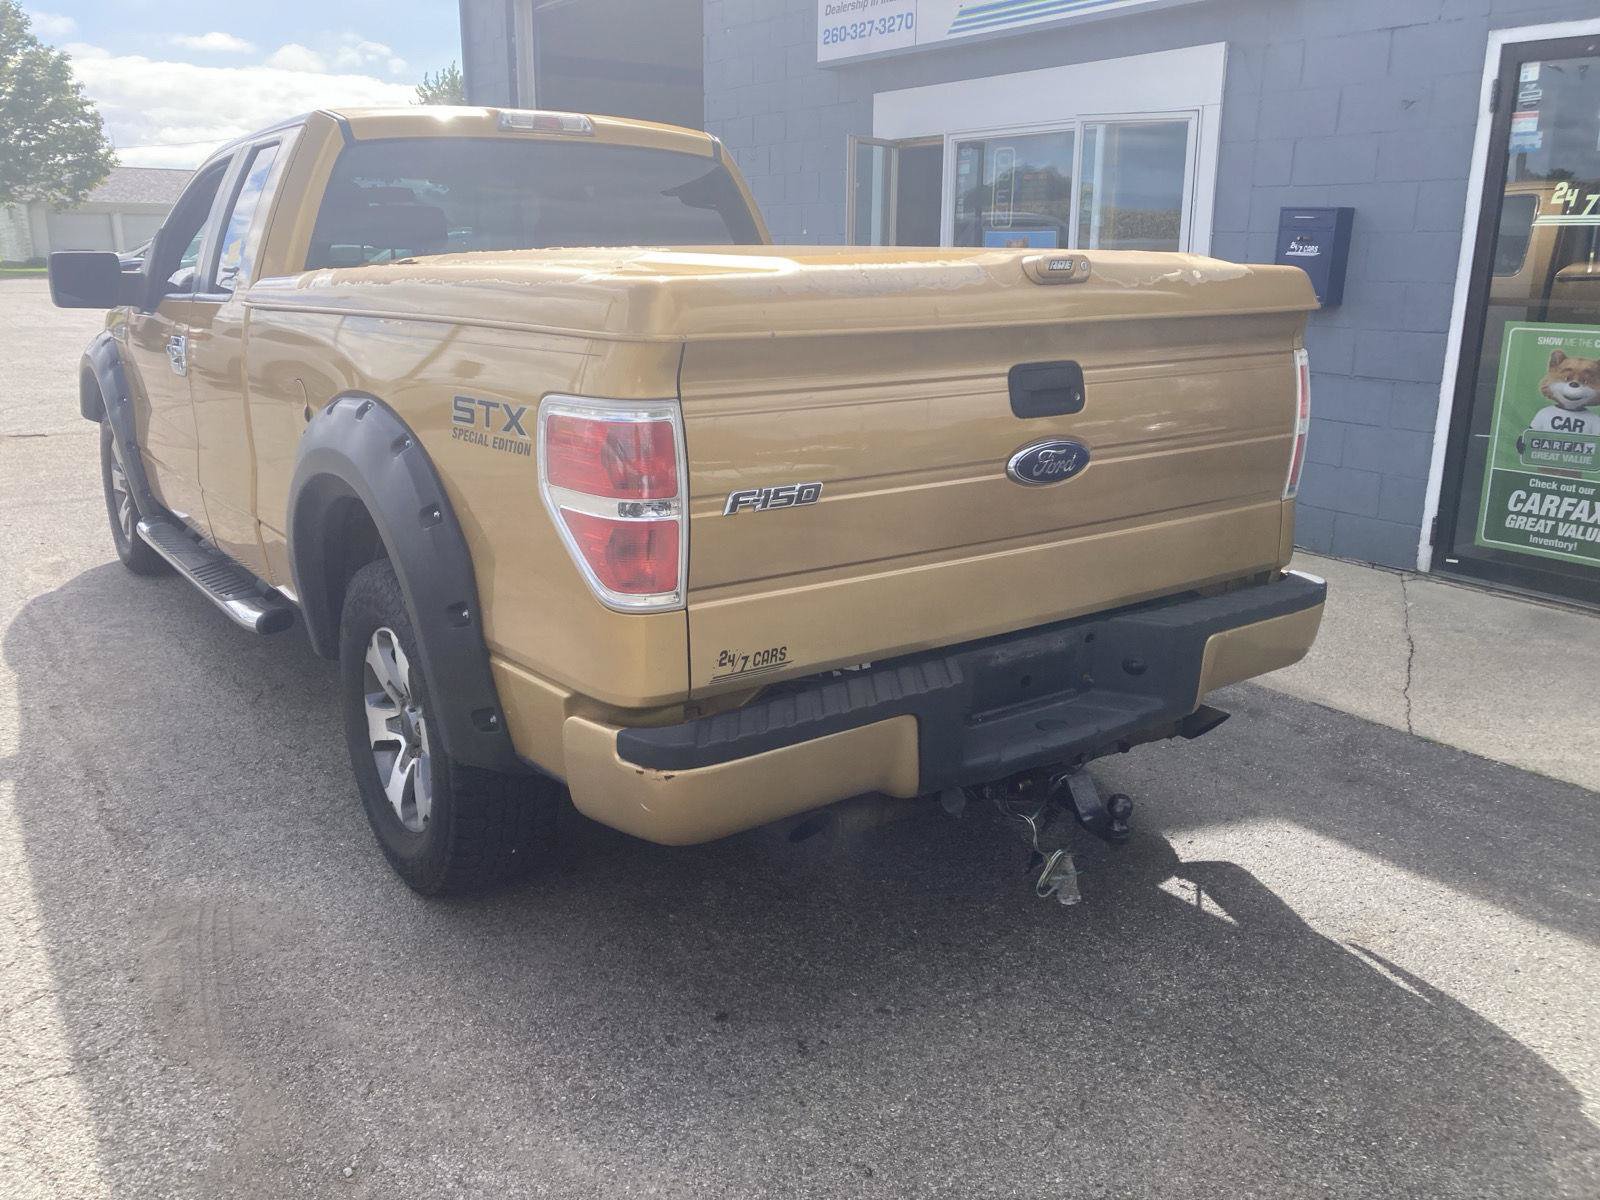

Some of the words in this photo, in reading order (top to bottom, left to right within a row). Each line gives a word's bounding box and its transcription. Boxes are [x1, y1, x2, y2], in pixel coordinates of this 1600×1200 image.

[823, 12, 914, 45] 260-327-3270
[1537, 336, 1564, 346] SHOW
[452, 395, 528, 437] STX
[1551, 415, 1585, 434] CAR
[452, 427, 489, 447] SPECIAL
[492, 437, 532, 457] EDITION
[1532, 439, 1595, 454] CARFAX
[1033, 448, 1077, 477] Ford
[1531, 451, 1561, 462] GREAT
[1563, 454, 1593, 464] VALUE
[1529, 478, 1558, 490] Check
[1560, 483, 1577, 493] out
[1578, 487, 1597, 495] our
[722, 482, 823, 516] F-150
[1505, 514, 1556, 534] GREAT
[1529, 533, 1578, 551] Inventory!
[719, 649, 750, 673] 24/7
[753, 646, 787, 668] CARS
